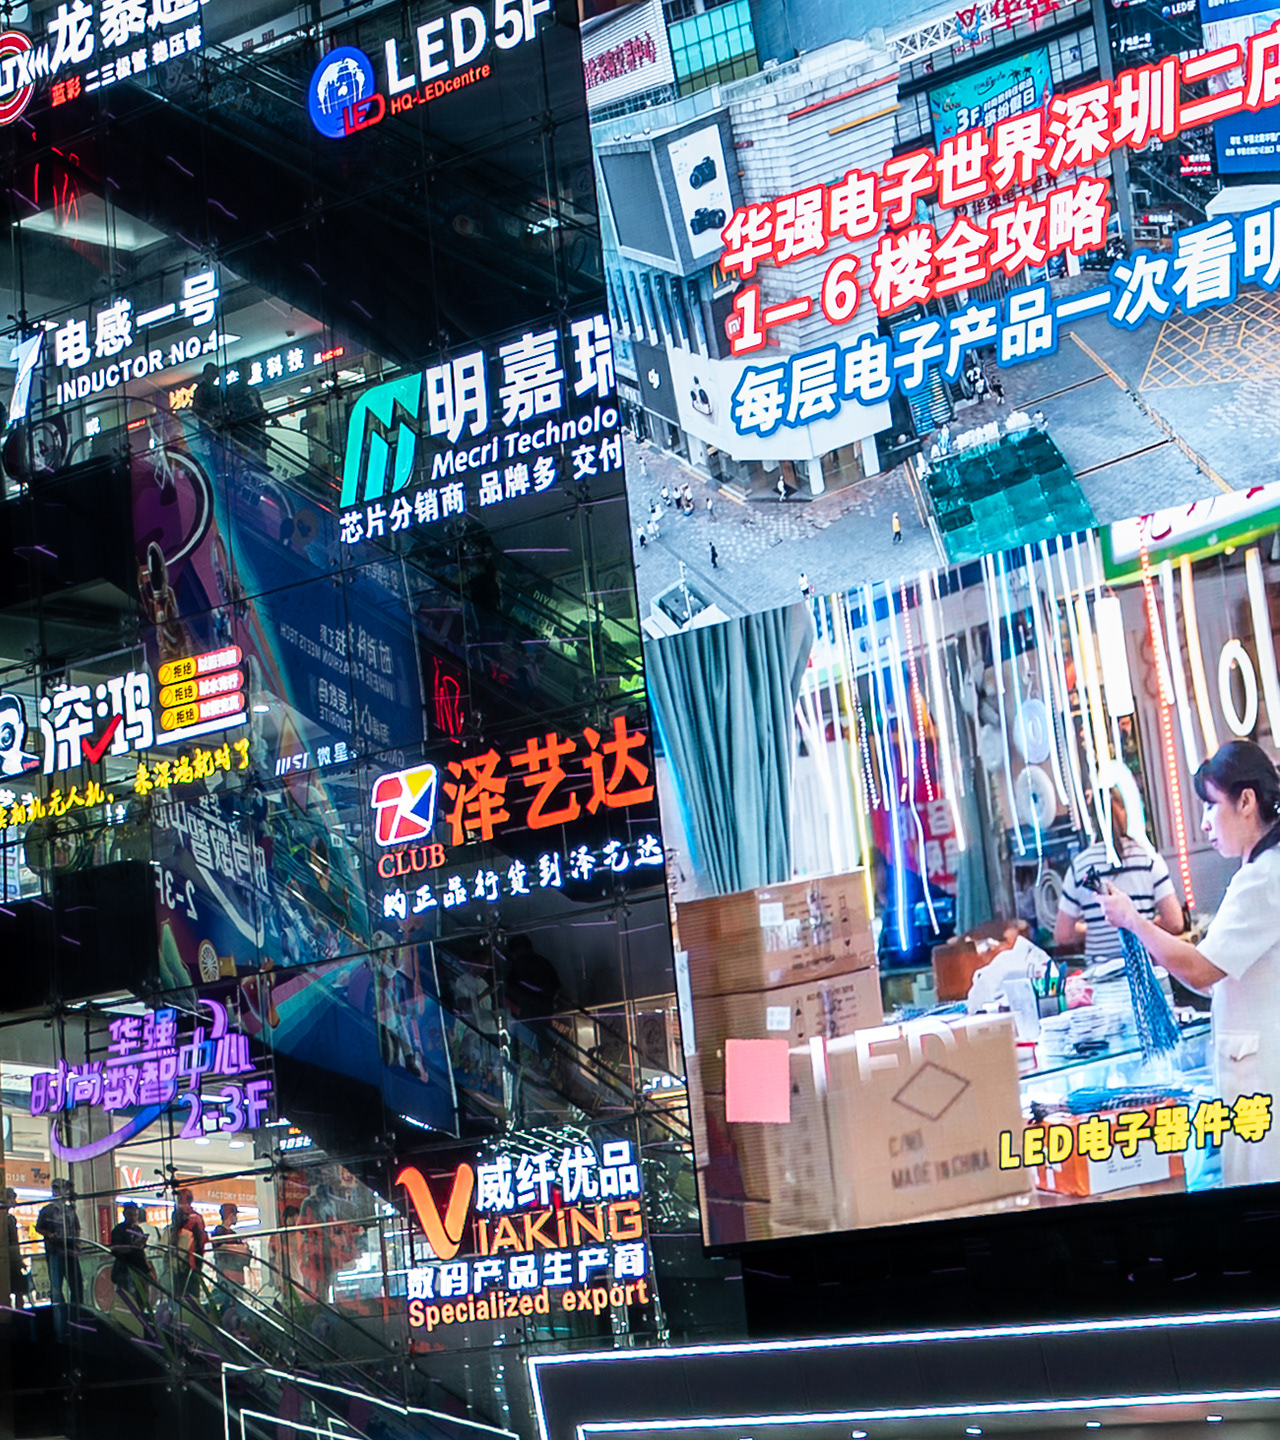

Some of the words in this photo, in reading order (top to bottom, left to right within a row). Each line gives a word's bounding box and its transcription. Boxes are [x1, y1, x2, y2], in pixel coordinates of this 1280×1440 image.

[51, 74, 82, 108] 蓝彩
[85, 48, 148, 93] 二三极管
[384, 5, 487, 96] LED
[341, 93, 387, 137] LED
[390, 63, 492, 116] HQ-LEDcentre
[54, 270, 220, 370] 电感一号
[56, 348, 165, 406] INDUCTOR
[430, 435, 499, 481] Mecri
[505, 405, 618, 456] Technolo
[340, 482, 466, 544] 芯片分销商
[479, 456, 557, 507] 品牌多
[571, 433, 623, 481] 交付
[174, 661, 193, 679] 拒绝
[175, 684, 193, 702] 拒绝
[40, 671, 155, 776] 深鸿
[176, 708, 195, 724] 拒绝
[133, 737, 250, 796] 来深鸿就对了
[442, 715, 654, 848] 泽艺达
[377, 842, 446, 879] CLUB
[383, 833, 665, 920] 购正品行货到泽艺达
[108, 1007, 178, 1056] 华强
[30, 1025, 257, 1117] 时尚数智中心
[178, 1079, 272, 1140] 2-3F
[998, 1092, 1273, 1170] LED电子器件等
[475, 1140, 640, 1212] 威纤优品
[406, 1242, 647, 1301] 数码产品生产商
[408, 1286, 550, 1332] Specialized
[561, 1277, 650, 1316] export
